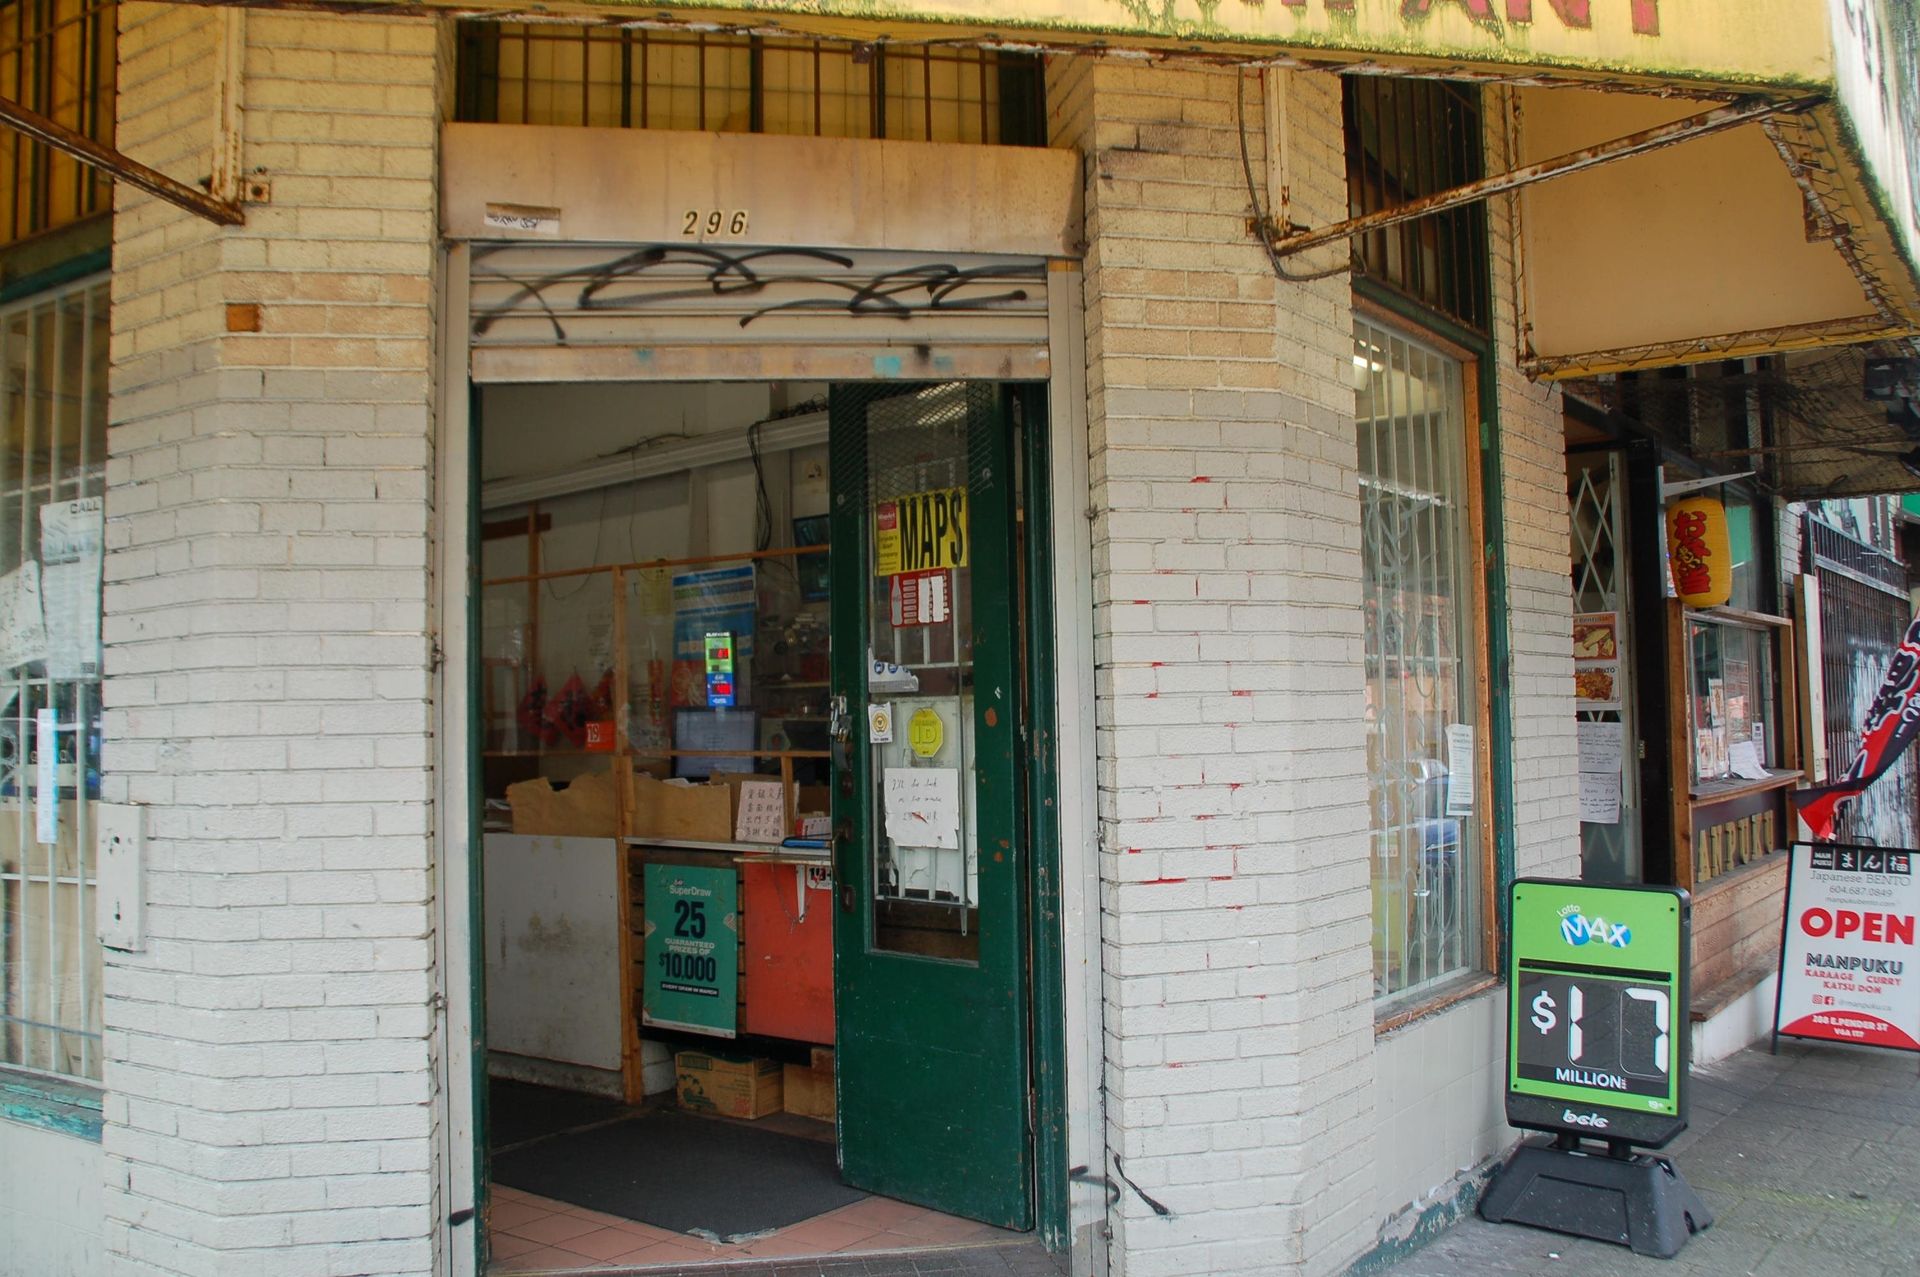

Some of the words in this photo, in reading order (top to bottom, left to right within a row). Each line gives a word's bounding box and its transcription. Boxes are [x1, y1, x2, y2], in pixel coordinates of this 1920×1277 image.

[682, 211, 746, 235] 296
[70, 500, 100, 514] CALL
[899, 489, 963, 571] MAPS
[912, 725, 938, 744] ID
[1810, 870, 1862, 883] Japanese
[1866, 873, 1911, 887] BENTO
[669, 885, 712, 897] SuperDraw
[674, 899, 706, 939] 25
[1556, 904, 1581, 917] Lotto
[1561, 914, 1627, 948] MAX
[1800, 907, 1915, 946] OPEN
[664, 938, 715, 949] GUARANTEED
[669, 945, 698, 954] PRIZES
[699, 948, 711, 956] OF
[659, 952, 716, 982] $10,000
[1805, 952, 1903, 975] MANPUKU
[1804, 969, 1853, 981] KARAAGE
[1866, 975, 1902, 986] CURRY
[1823, 981, 1855, 991] KATSU
[1858, 985, 1882, 994] DON
[1555, 1067, 1621, 1089] MILLION
[1562, 1109, 1609, 1128] bclc
